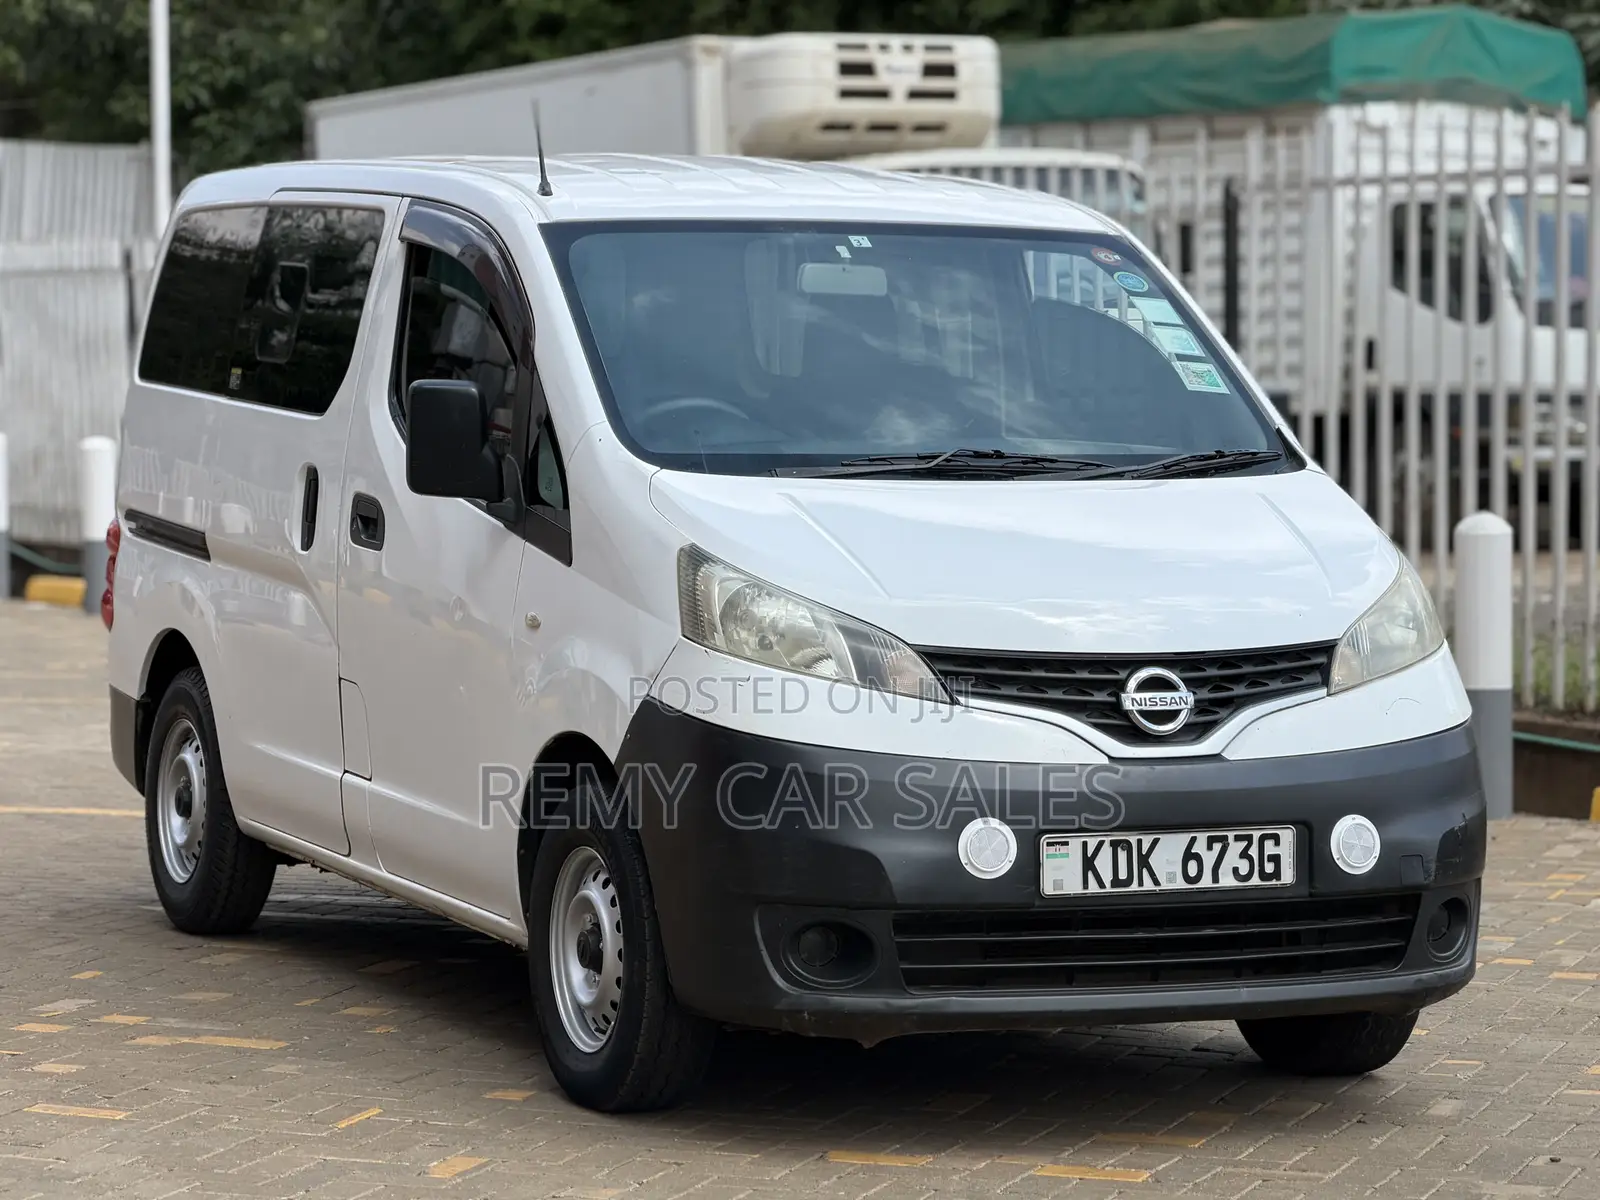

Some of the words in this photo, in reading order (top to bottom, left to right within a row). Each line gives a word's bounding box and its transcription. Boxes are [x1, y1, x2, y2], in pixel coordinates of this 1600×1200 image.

[1130, 695, 1189, 708] NISSAN
[1081, 836, 1162, 891] KDK
[1181, 832, 1283, 885] 673G
